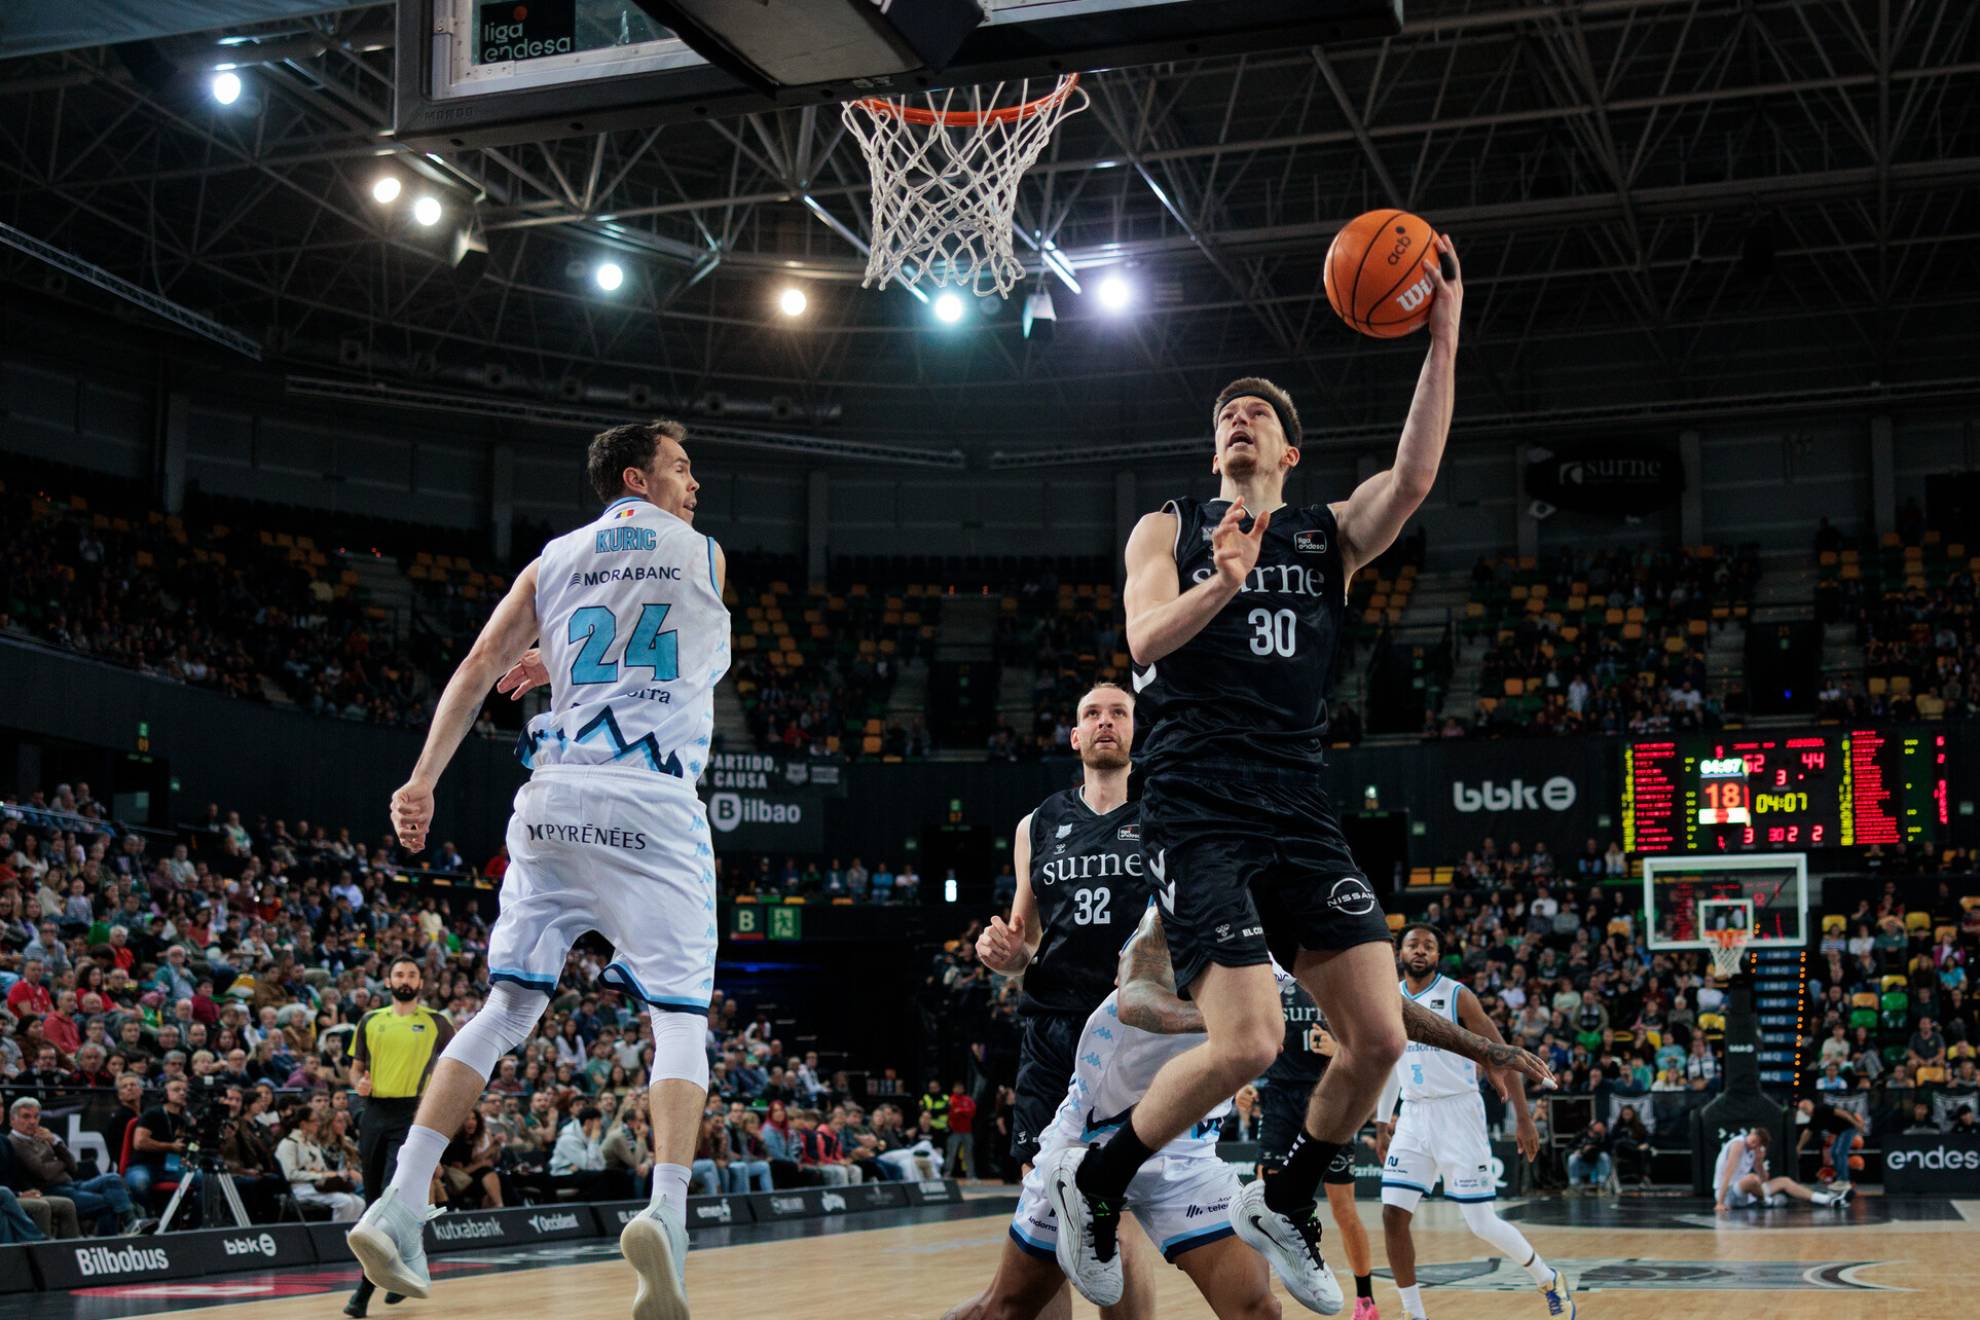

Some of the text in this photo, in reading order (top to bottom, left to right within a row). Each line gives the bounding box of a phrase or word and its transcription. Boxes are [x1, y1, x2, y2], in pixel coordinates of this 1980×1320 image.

[484, 22, 523, 43] liga
[484, 36, 571, 63] endesa
[1387, 236, 1412, 266] acb
[1586, 458, 1662, 477] surne
[595, 526, 657, 554] KURIC
[584, 566, 681, 587] MORABANC
[1192, 563, 1325, 597] srne
[568, 603, 679, 686] 24
[1248, 607, 1297, 658] 30
[1801, 752, 1825, 769] 44
[714, 771, 768, 788] CAUSA
[1776, 769, 1787, 786] 3
[1453, 778, 1540, 813] bbk
[1705, 782, 1741, 808] 18
[1756, 792, 1808, 813] 04:07
[713, 795, 802, 828] Bilbao
[1042, 853, 1144, 886] surne
[1074, 887, 1111, 926] 32
[1327, 891, 1375, 907] NISSAN
[738, 910, 755, 932] B
[1887, 1144, 1980, 1170] endes
[431, 1216, 504, 1240] kutxabank
[540, 1213, 579, 1231] Occident
[223, 1237, 260, 1255] bbk
[75, 1244, 170, 1276] Bilbobus
